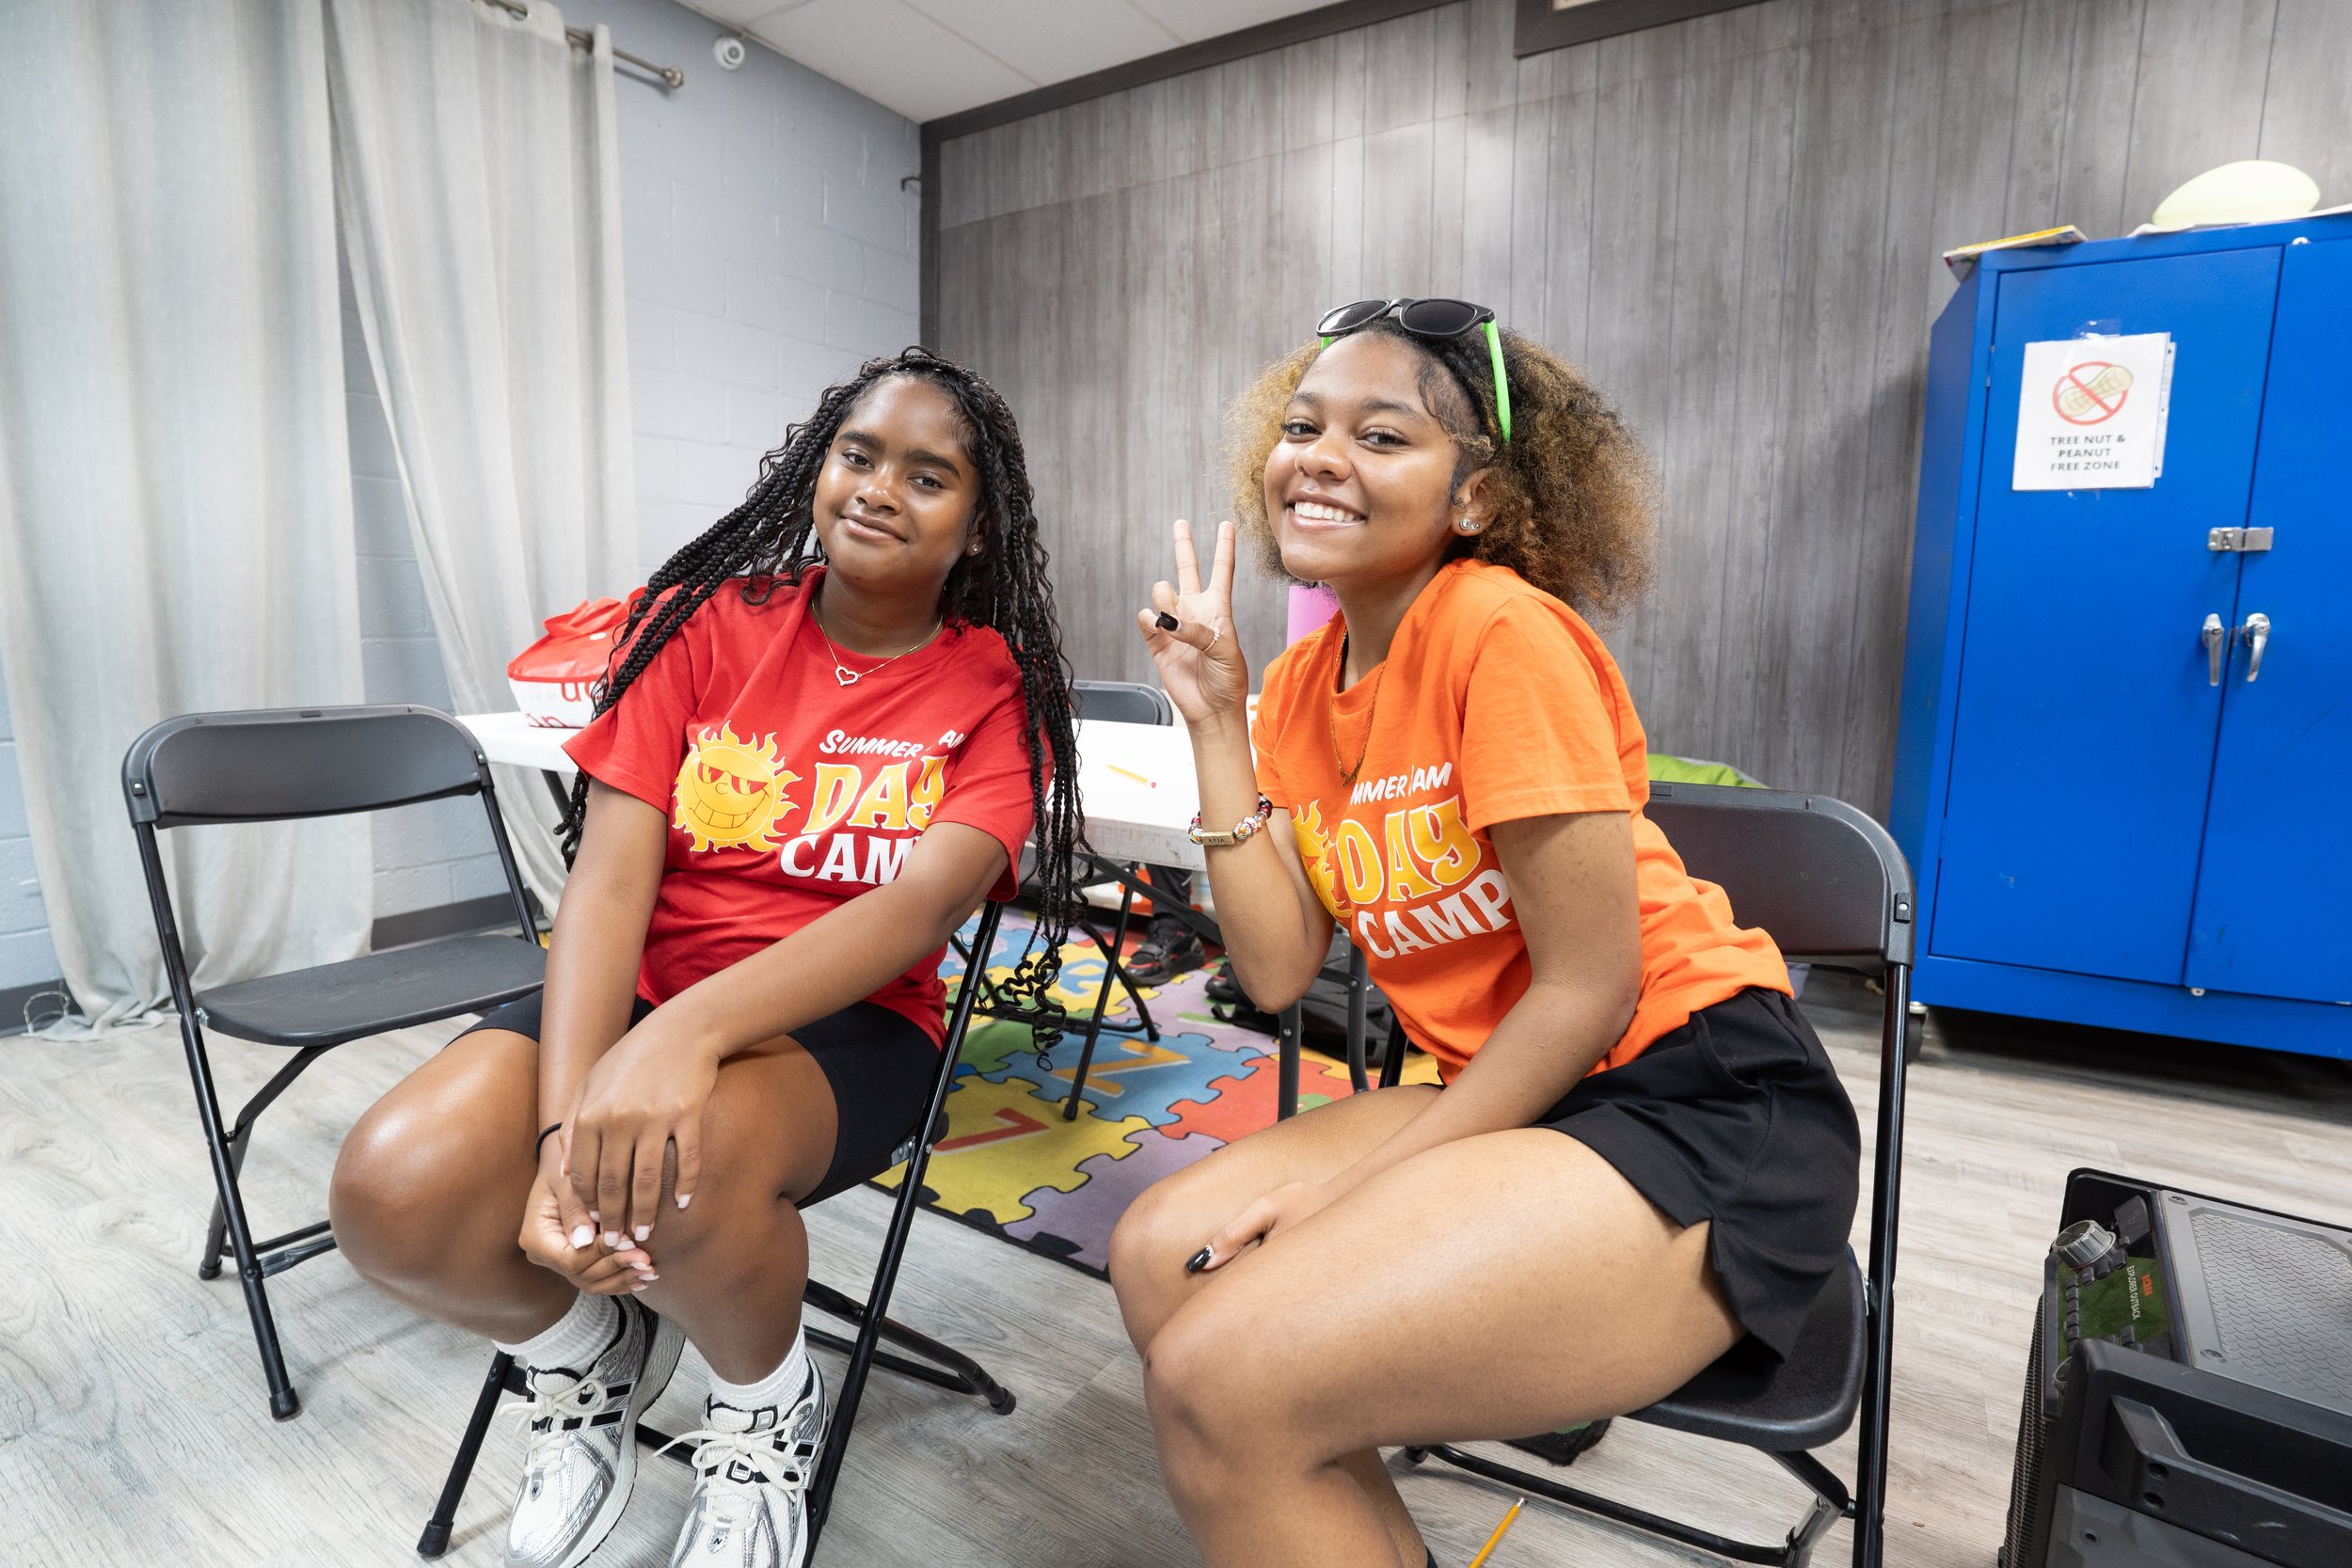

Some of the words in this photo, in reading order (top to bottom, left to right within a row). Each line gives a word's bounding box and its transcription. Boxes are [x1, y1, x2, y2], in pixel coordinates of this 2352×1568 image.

[2050, 436, 2079, 445] TREE
[2084, 434, 2112, 444] NUT
[2117, 435, 2125, 443] &
[2050, 462, 2078, 471] FREE
[2084, 460, 2122, 470] ZONE
[2058, 449, 2111, 458] PEANUT
[801, 754, 949, 834] DAY
[780, 832, 921, 885] CAM
[1335, 794, 1481, 905] DAY
[1358, 868, 1512, 959] CAMP
